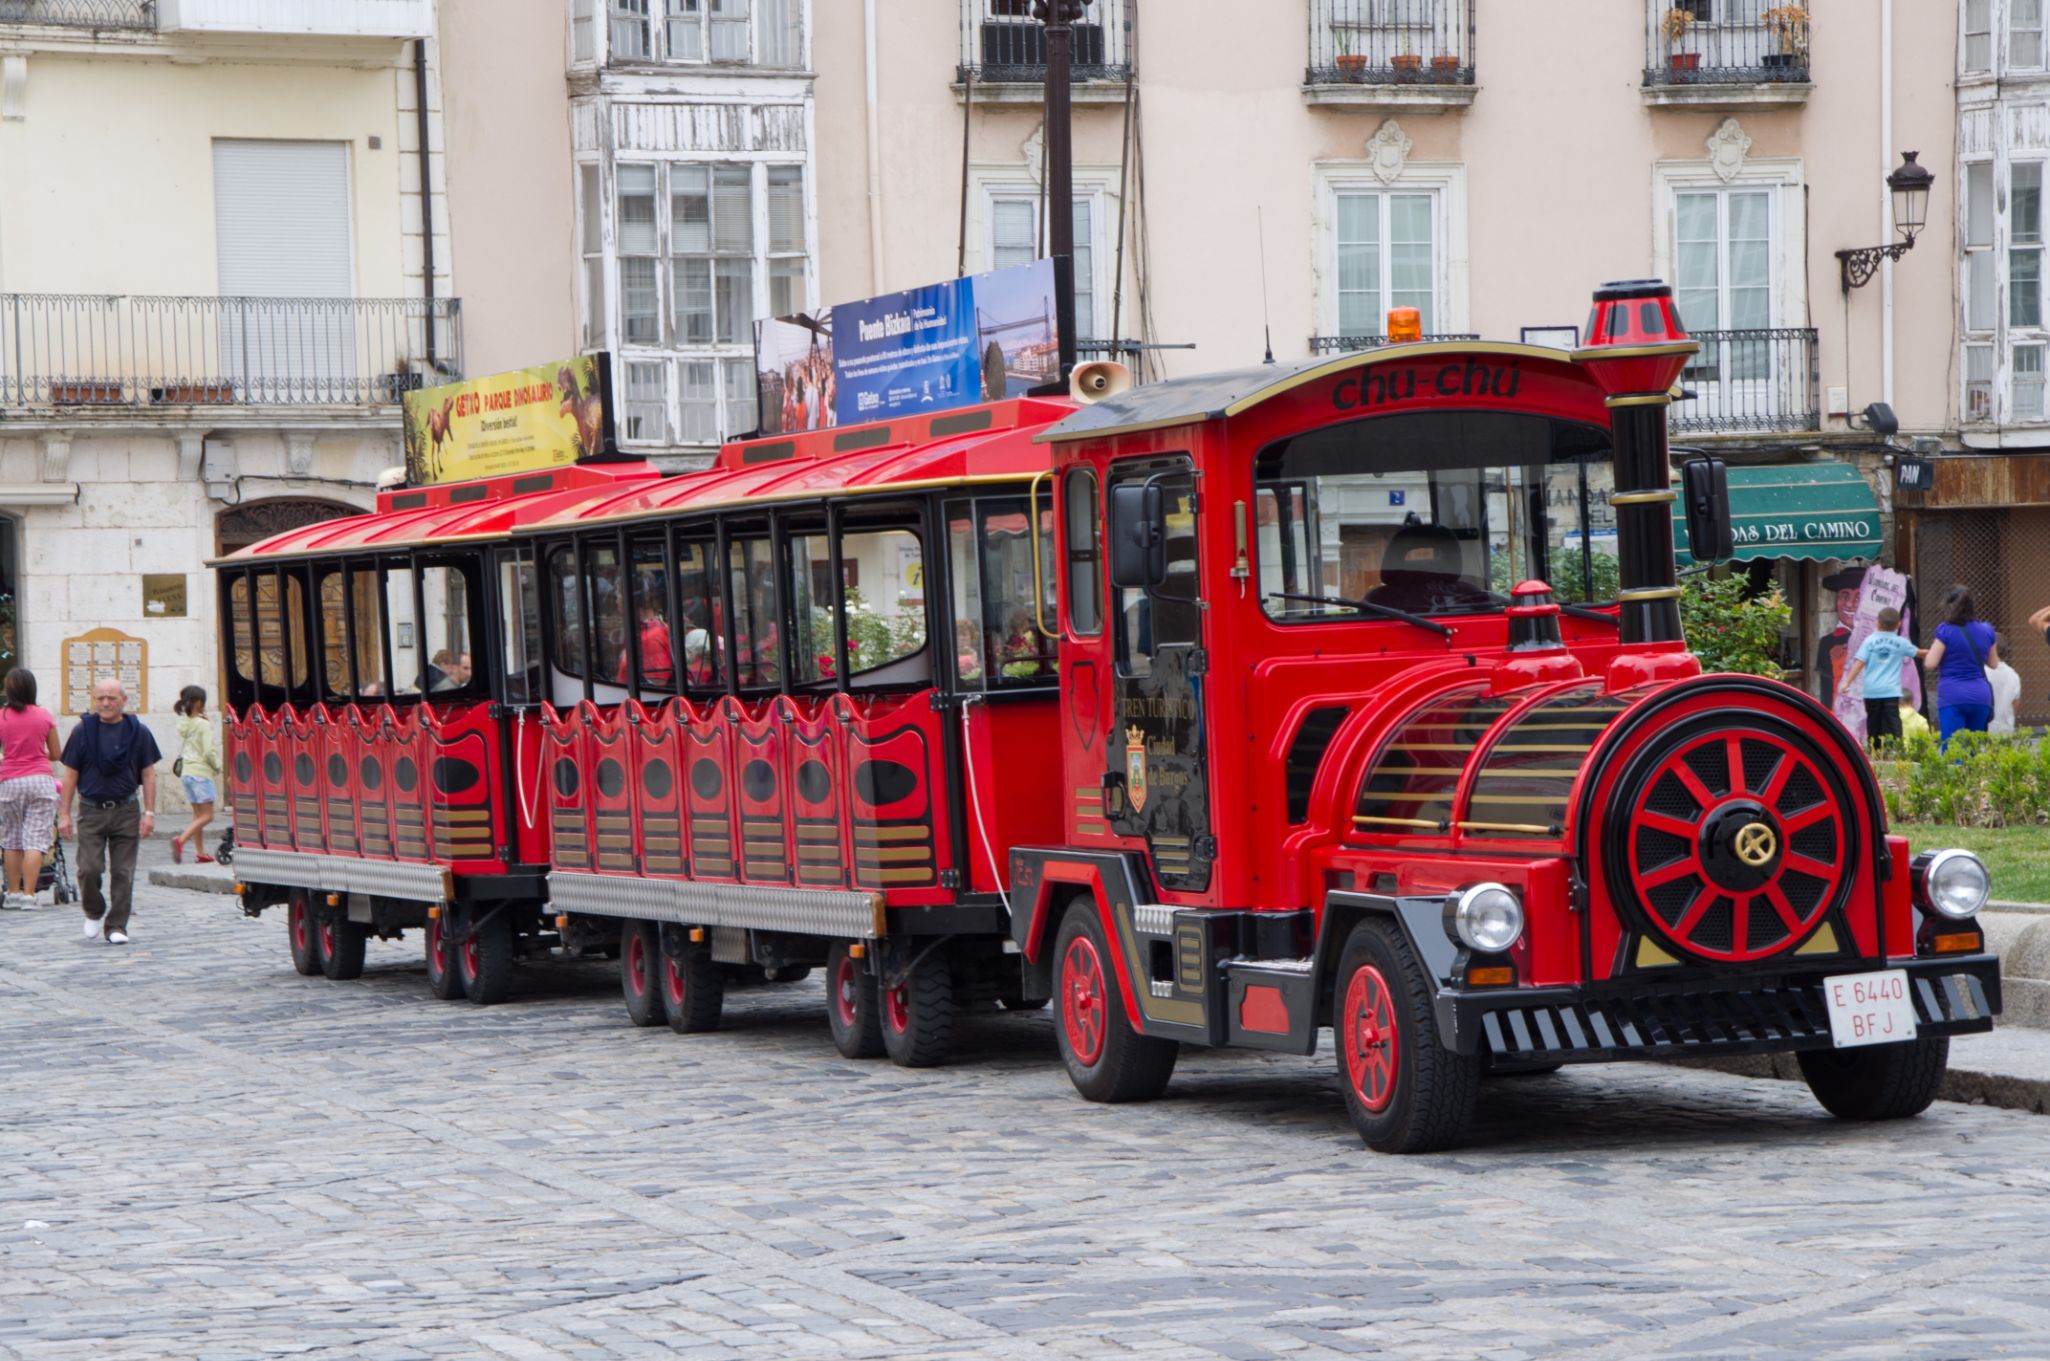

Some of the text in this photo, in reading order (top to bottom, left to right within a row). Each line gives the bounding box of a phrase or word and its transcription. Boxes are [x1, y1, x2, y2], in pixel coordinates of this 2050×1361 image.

[859, 311, 911, 342] Puente Bizkaia
[484, 390, 512, 412] PARQUE
[1900, 464, 1920, 485] PAN
[1764, 523, 1798, 541] DEL
[1805, 520, 1870, 539] CAMINO
[1147, 735, 1175, 755] Ciudad
[1159, 767, 1190, 793] Burgos
[1834, 977, 1903, 1007] E 6440
[1852, 1011, 1894, 1038] BFJ
